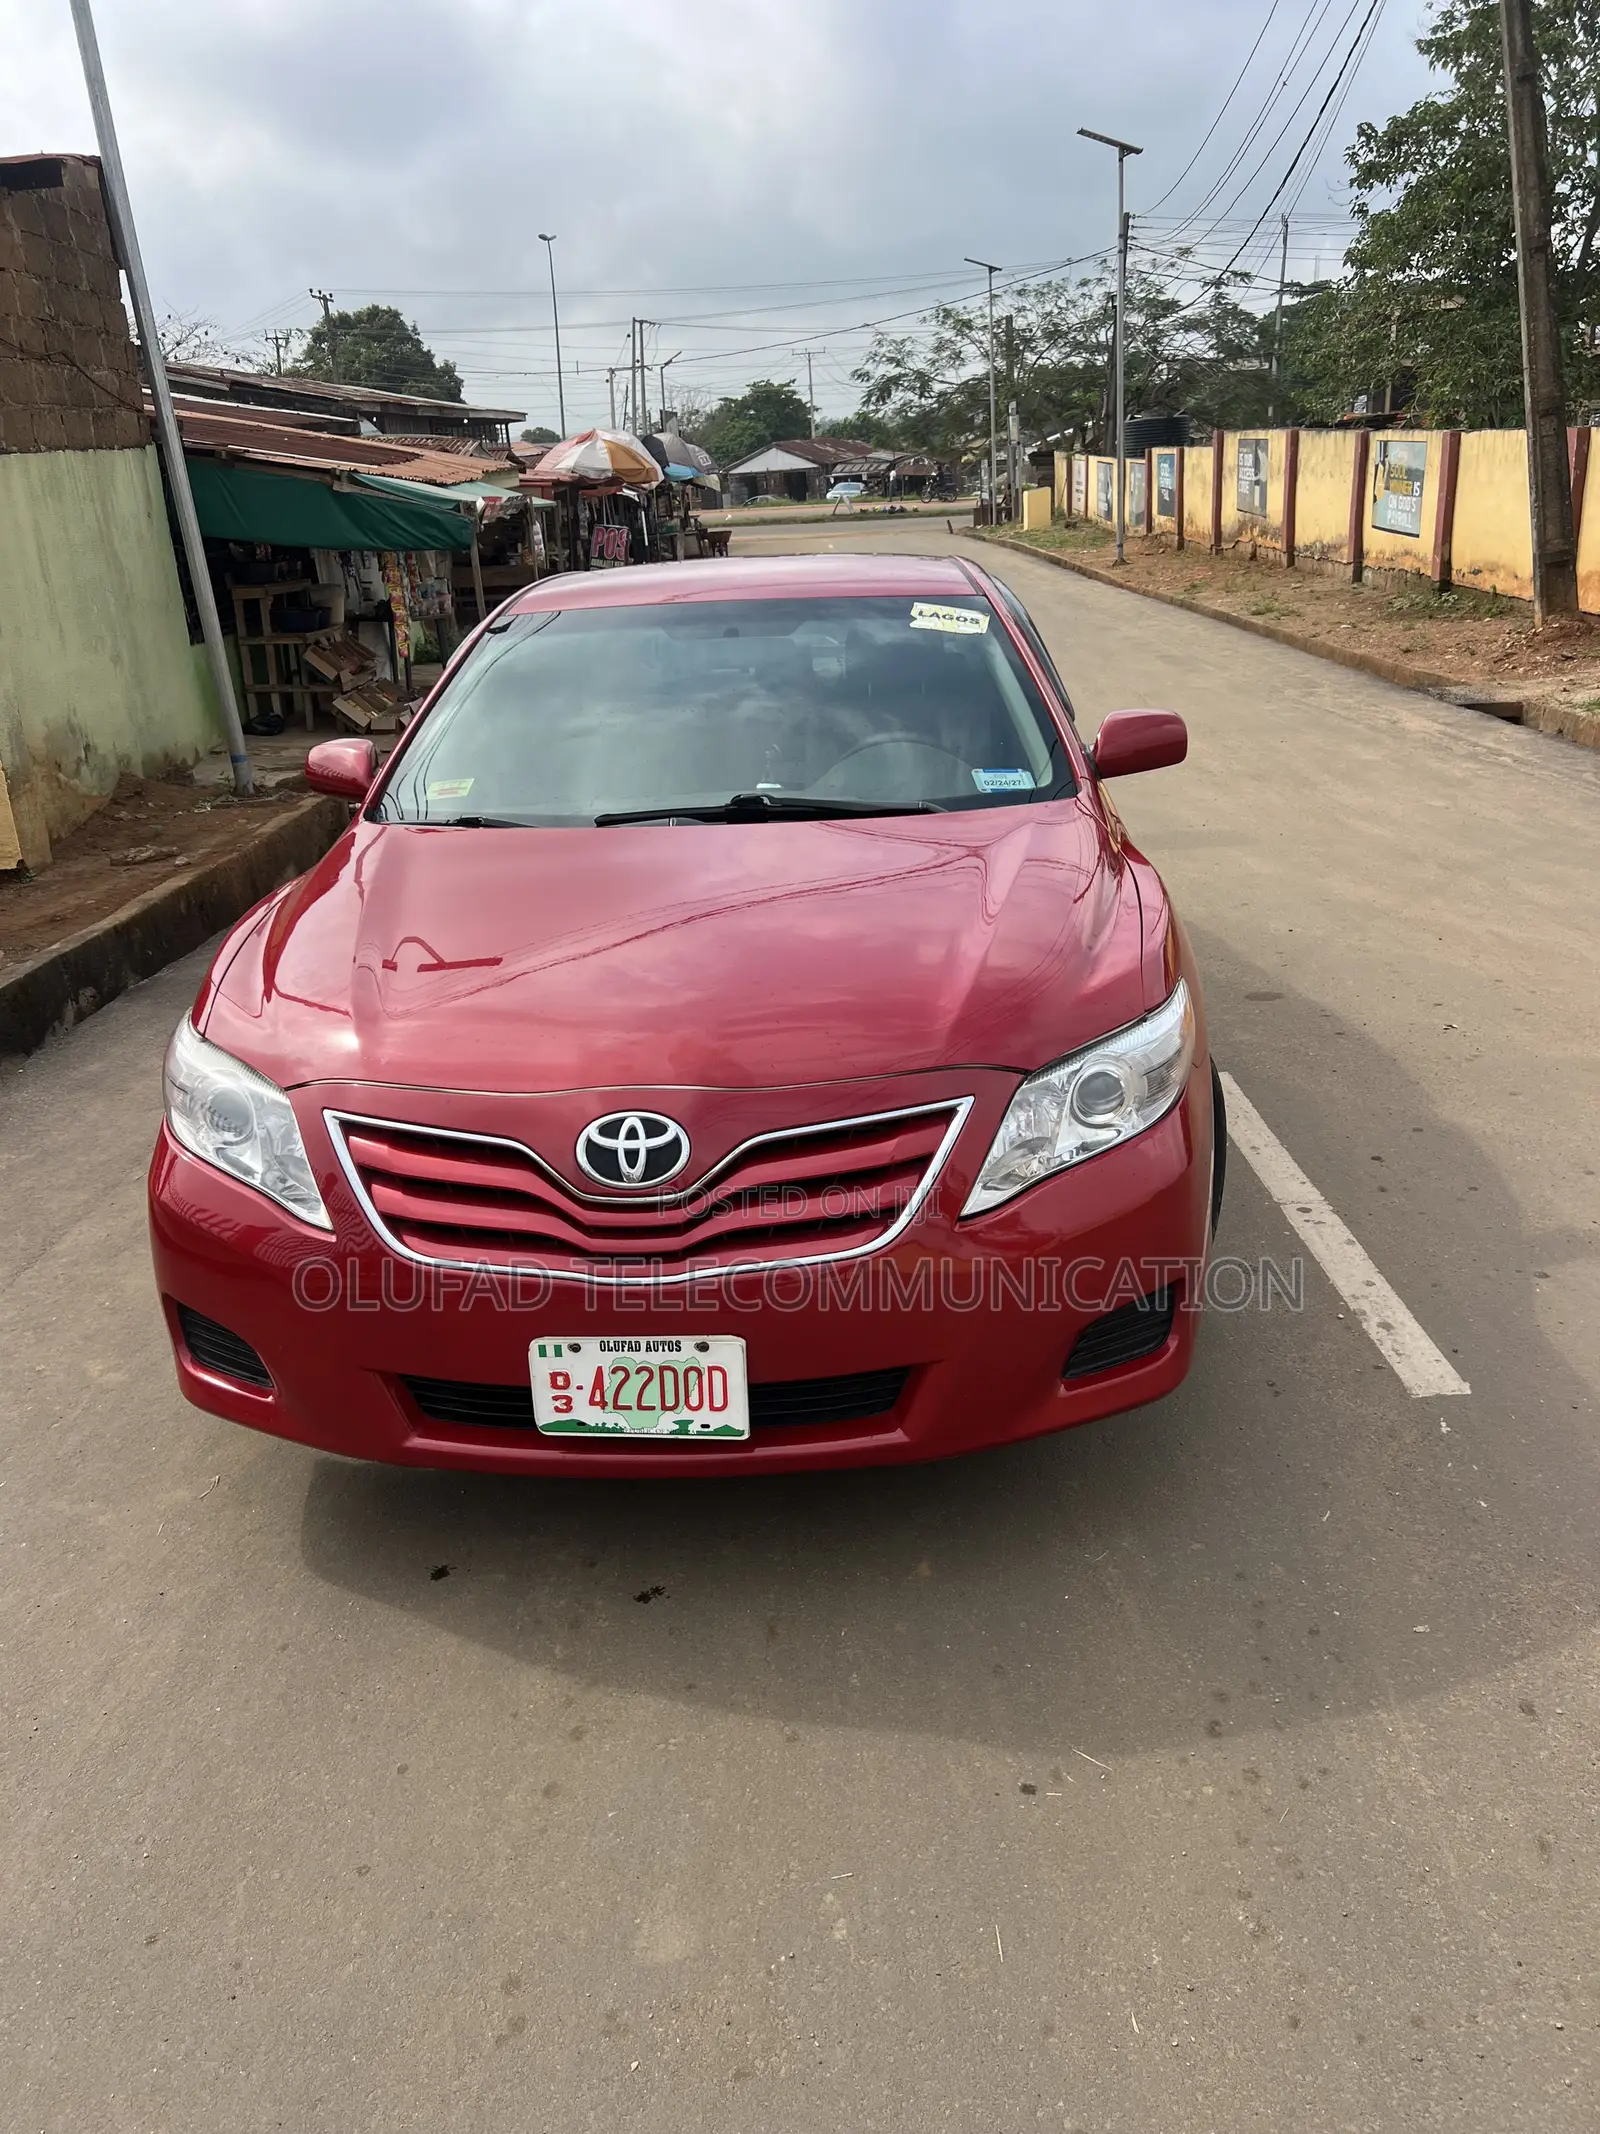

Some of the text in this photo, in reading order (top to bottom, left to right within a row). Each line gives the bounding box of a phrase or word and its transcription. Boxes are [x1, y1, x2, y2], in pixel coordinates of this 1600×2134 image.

[1413, 481, 1421, 497] IS
[1388, 495, 1398, 509] ON
[1387, 510, 1413, 529] PAYROLL
[592, 526, 627, 561] POS
[917, 609, 980, 625] LAGOS
[599, 1340, 682, 1353] OLUFAD AUTOS
